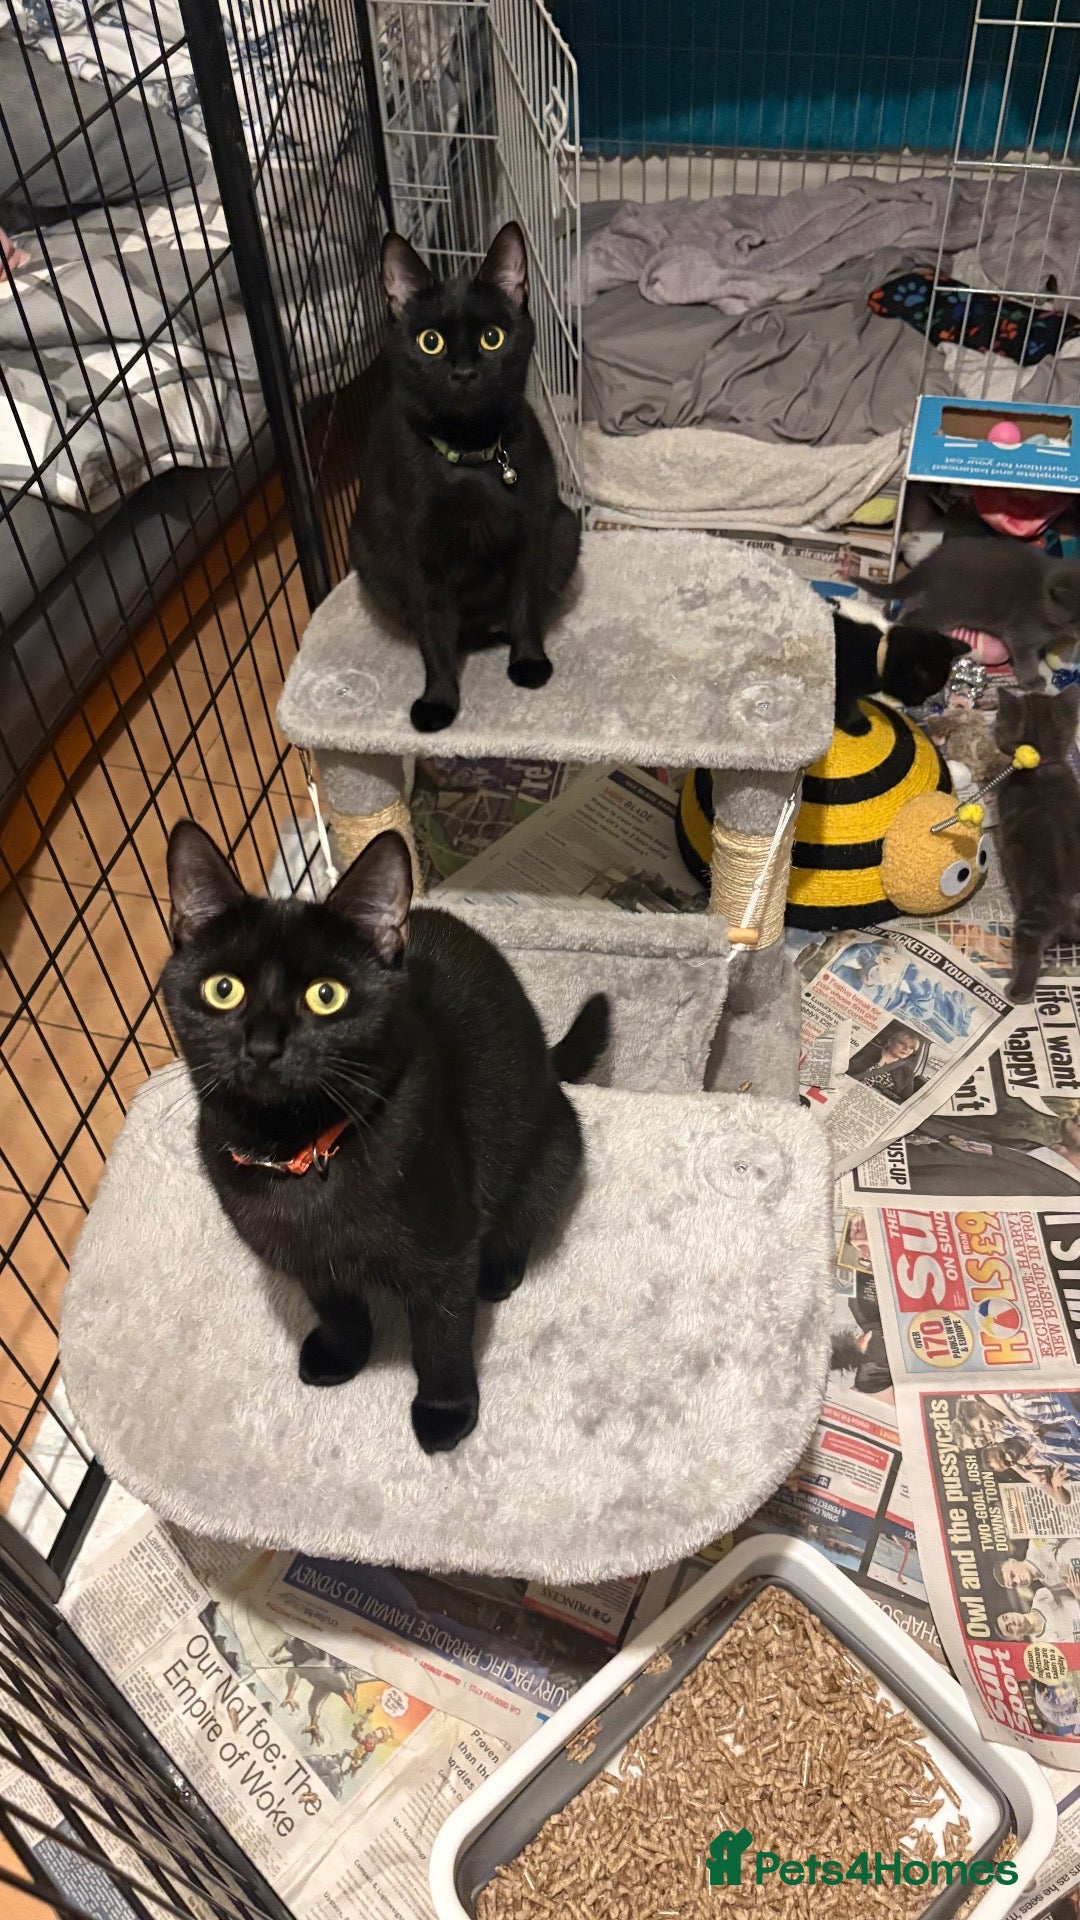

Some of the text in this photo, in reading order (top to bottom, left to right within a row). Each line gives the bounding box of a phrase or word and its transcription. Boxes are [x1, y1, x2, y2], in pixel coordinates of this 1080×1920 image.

[932, 464, 1079, 482] Complete and balanced
[966, 457, 995, 467] your
[997, 461, 1013, 469] for
[1015, 462, 1068, 472] nutrition
[882, 929, 942, 964] POCKETED
[941, 959, 974, 988] YOUR
[972, 984, 1007, 1012] CASH
[810, 996, 833, 1014] Luxury
[1035, 984, 1071, 1016] life
[1003, 1026, 1040, 1090] happy
[1047, 1035, 1080, 1090] want
[889, 1137, 907, 1186] UST-UP
[883, 1208, 900, 1239] THE
[932, 1210, 953, 1261] SUND
[955, 1211, 1007, 1257] £9
[1019, 1211, 1037, 1245] FRO
[959, 1232, 972, 1255] FROM
[1027, 1245, 1042, 1260] IN
[945, 1260, 960, 1281] ON
[1008, 1216, 1055, 1358] EXCLUSIVE: HARRY
[1032, 1263, 1059, 1320] BUST-UP
[912, 1331, 923, 1349] OVER
[920, 1320, 950, 1359] 170
[949, 1334, 961, 1359] PARKS
[953, 1320, 968, 1347] EUROPE
[1051, 1324, 1068, 1358] NEW
[929, 1399, 991, 1639] Owl and the pussycats
[965, 1455, 995, 1552] TWO-GOAL JOSH
[982, 1471, 1009, 1552] DOWNS TOON
[146, 1530, 176, 1570] Lawless
[174, 1569, 200, 1602] streets
[291, 1564, 346, 1599] SYDNEY
[345, 1587, 364, 1609] TO
[363, 1596, 417, 1634] HAWAII
[414, 1619, 483, 1667] PARADISE
[873, 1599, 941, 1648] HAPSO
[480, 1653, 535, 1692] PACIFIC
[973, 1644, 1015, 1728] sun
[994, 1647, 1031, 1735] sport
[187, 1634, 223, 1680] Our
[247, 1718, 287, 1770] foe:
[284, 1759, 322, 1816] The
[162, 1658, 294, 1838] Empire of Woke
[458, 1741, 477, 1765] than
[471, 1730, 500, 1764] Proven
[403, 1828, 427, 1860] Technology
[354, 1859, 373, 1883] Compact
[377, 1889, 405, 1920] Lightweigh
[1019, 1874, 1071, 1913] as he sees
